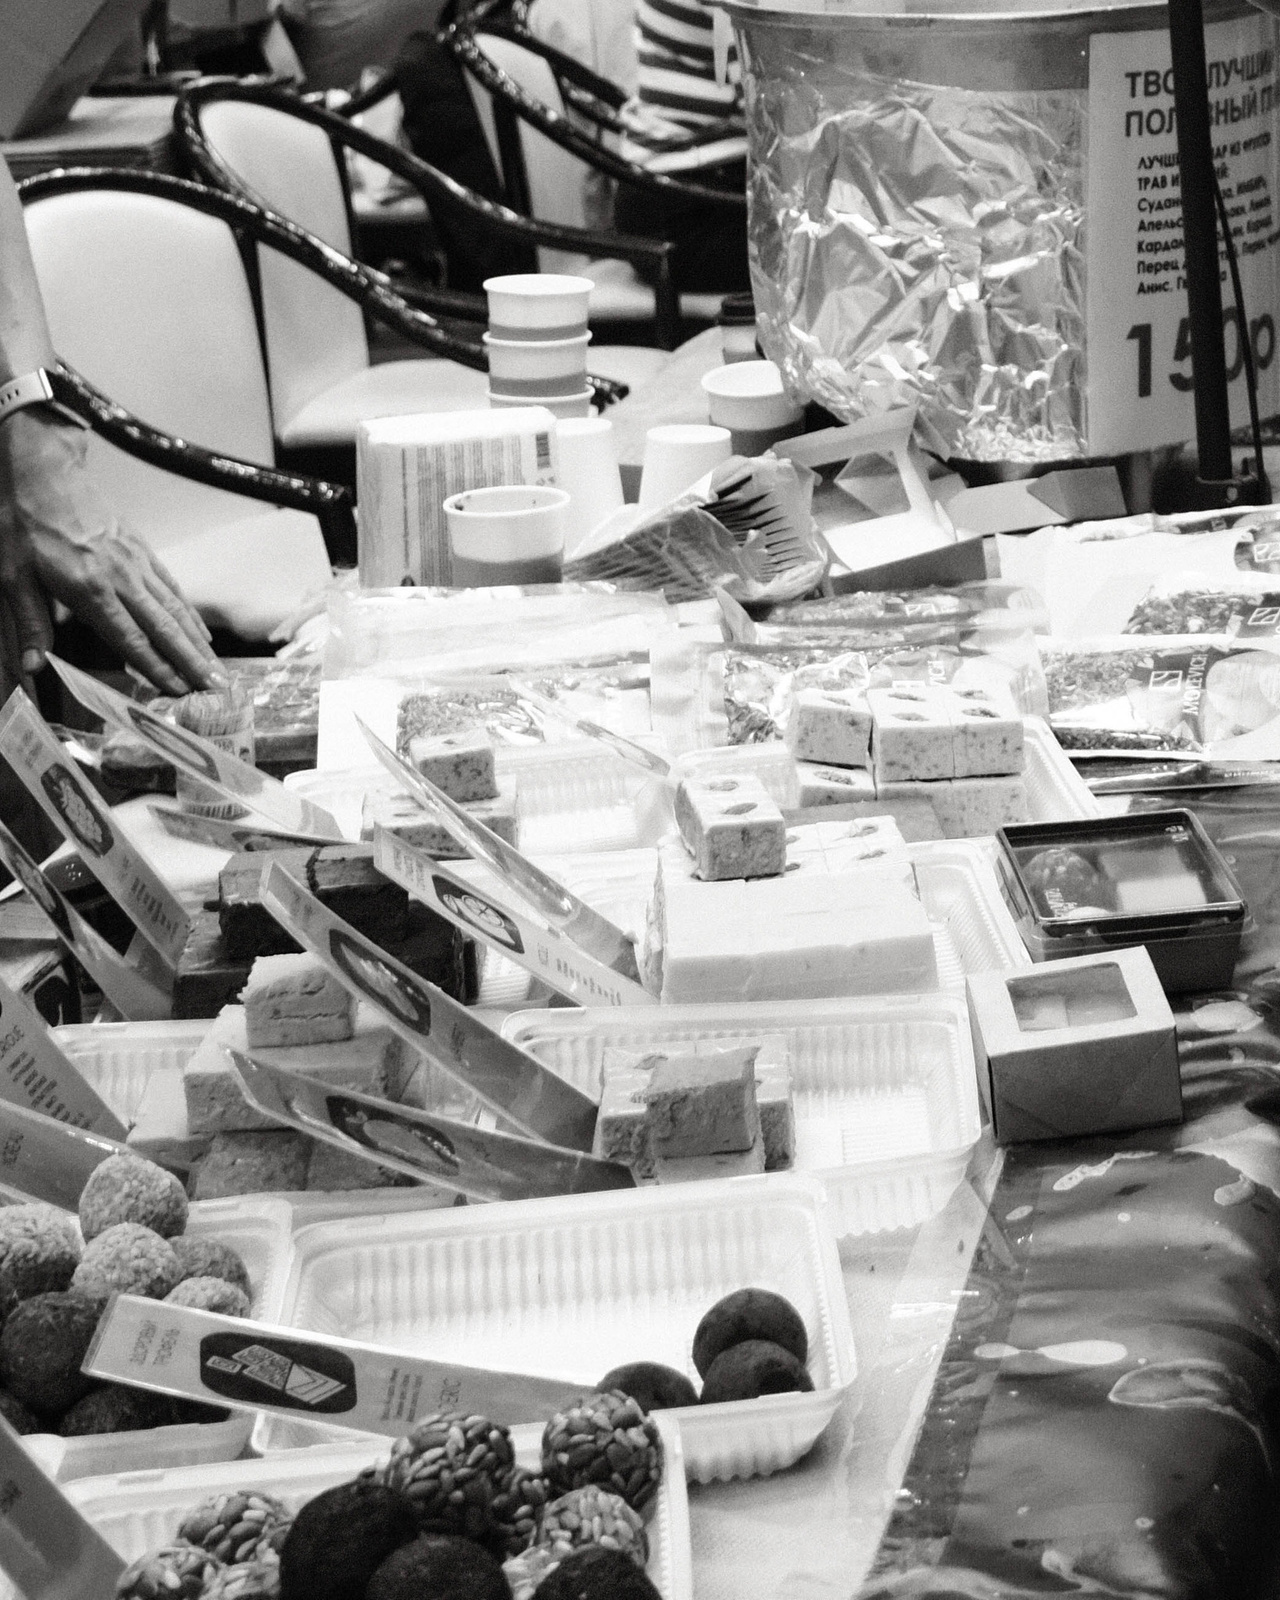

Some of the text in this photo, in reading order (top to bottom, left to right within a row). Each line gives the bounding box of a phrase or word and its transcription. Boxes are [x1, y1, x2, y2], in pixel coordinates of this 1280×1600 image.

[1125, 67, 1175, 99] ТВО
[1125, 85, 1258, 138] ПОЛНЫЙ
[1137, 175, 1168, 191] ТРАВ
[1137, 260, 1179, 276] Перец
